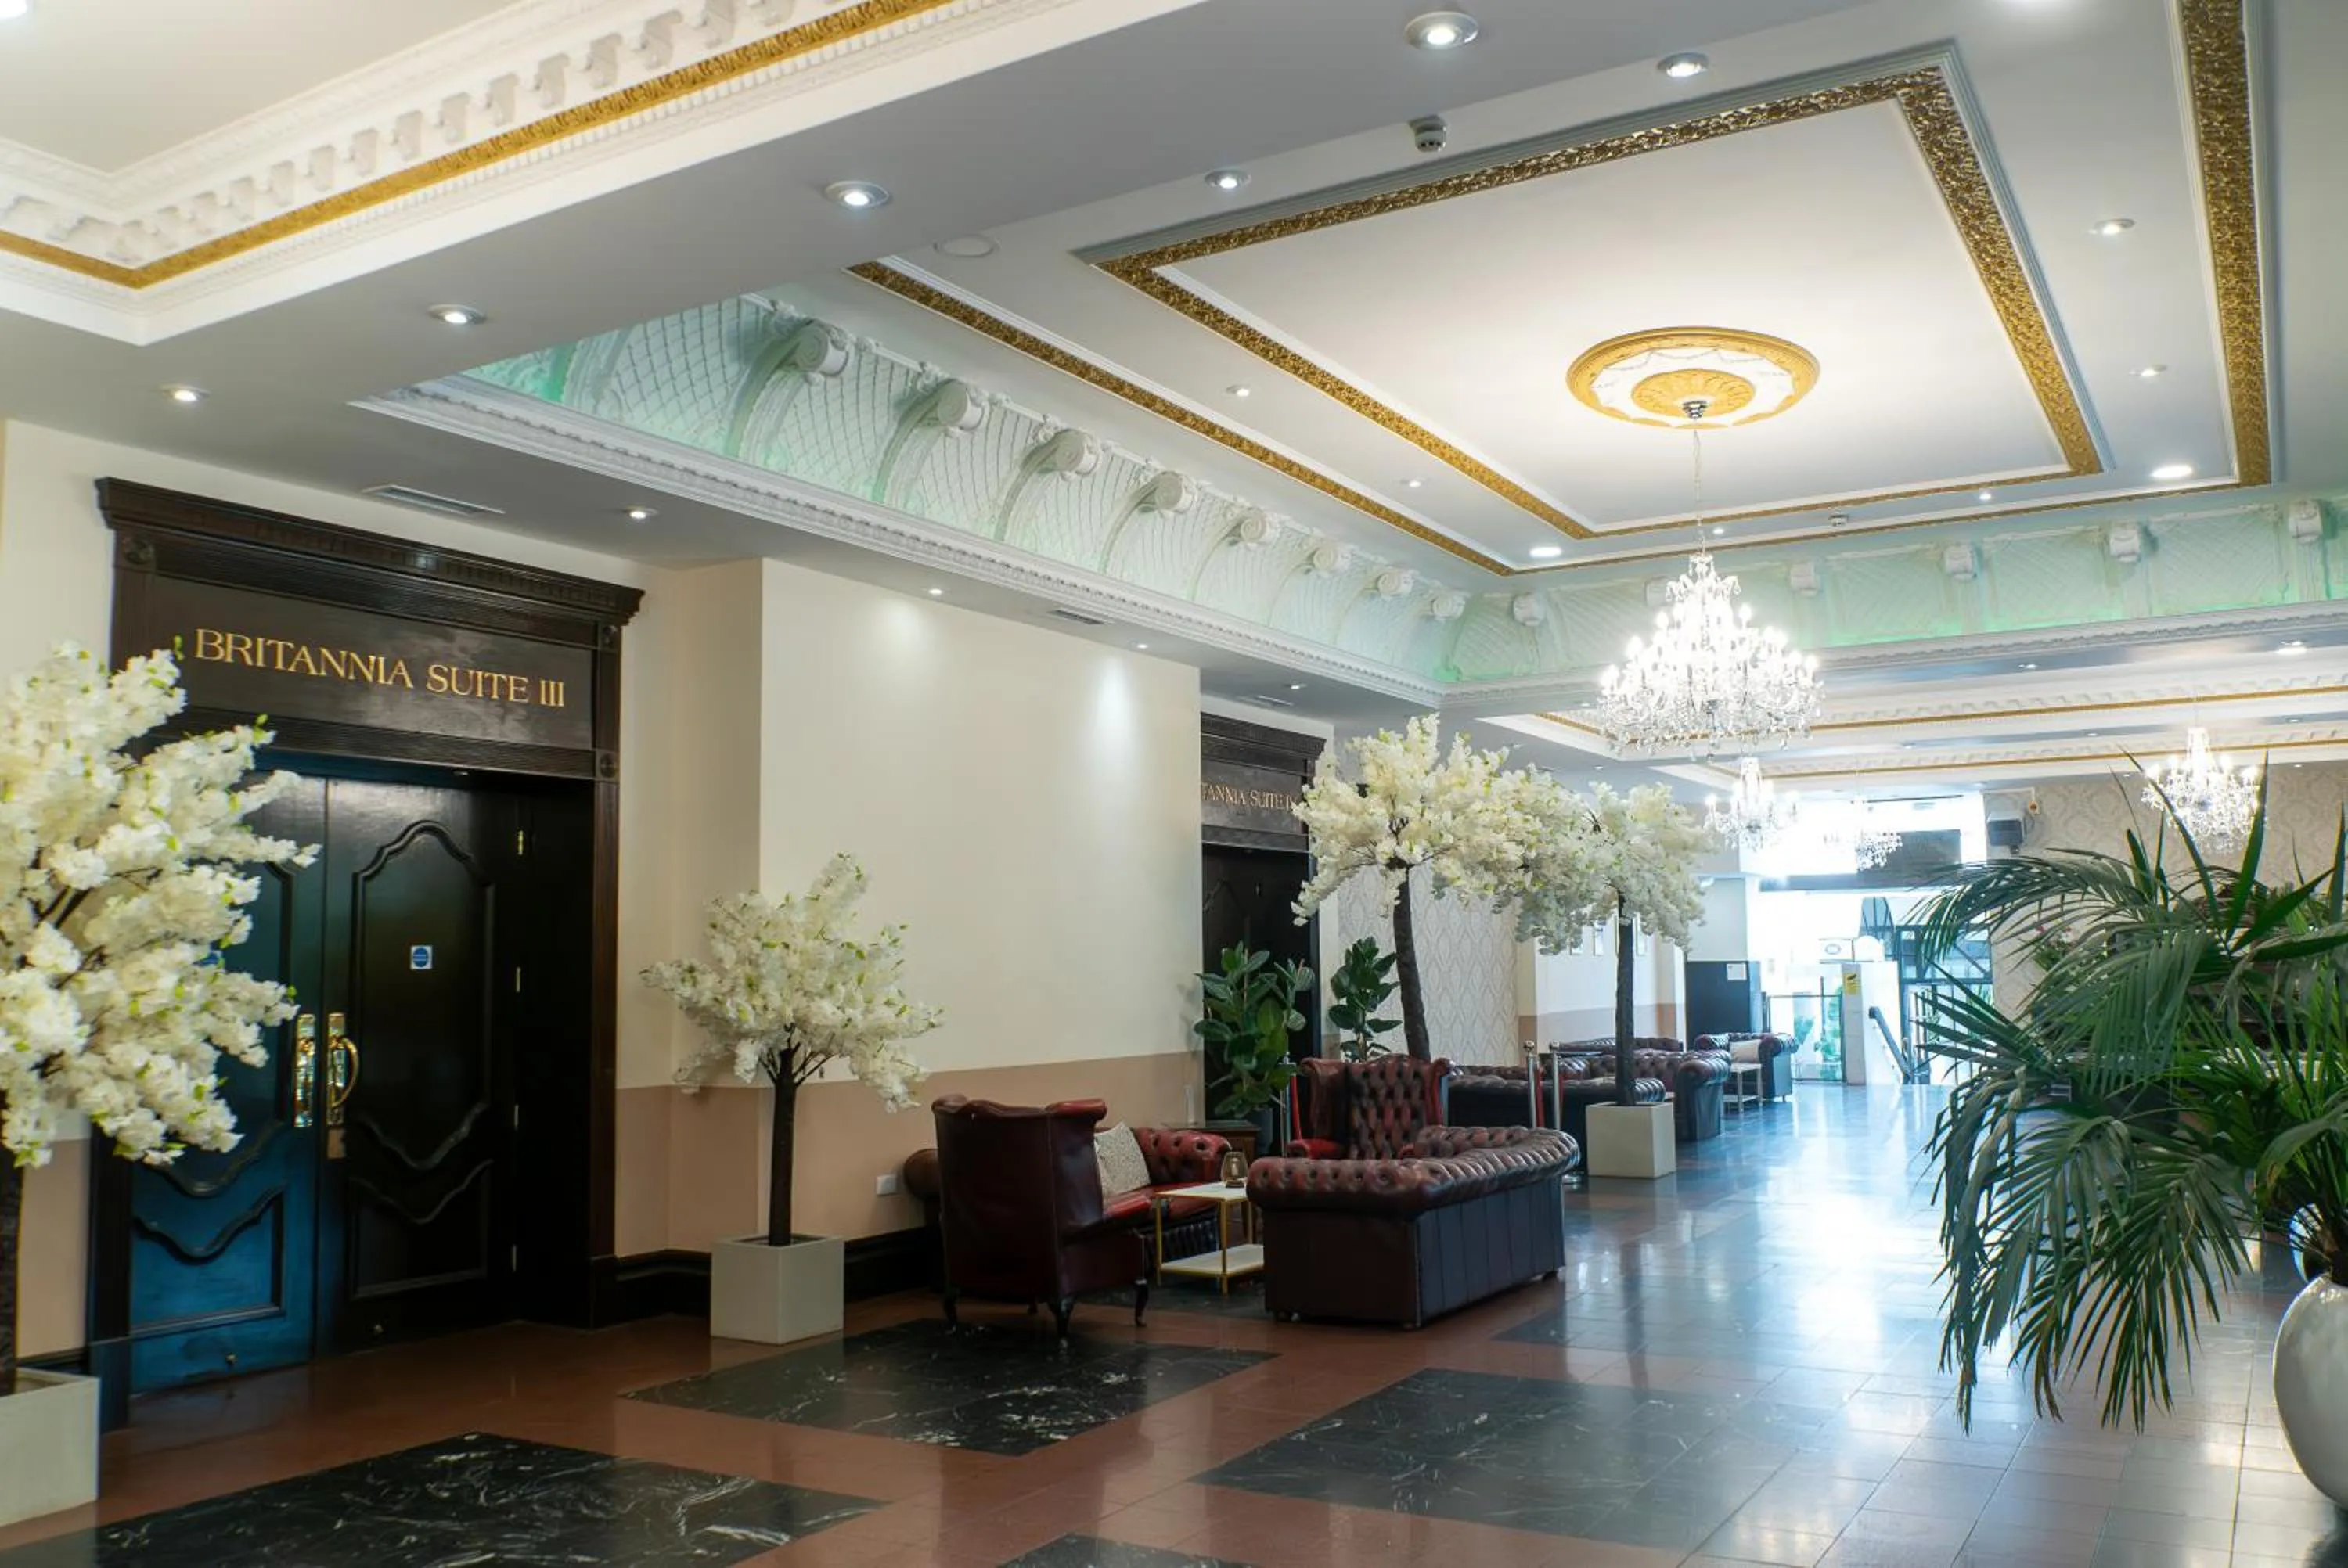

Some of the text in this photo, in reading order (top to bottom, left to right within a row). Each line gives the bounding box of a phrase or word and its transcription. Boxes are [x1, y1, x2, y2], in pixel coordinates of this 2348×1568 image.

[194, 628, 565, 707] BRITANNIA SUITE III
[1201, 782, 1246, 807] TANNIA
[1250, 789, 1285, 810] SUITE
